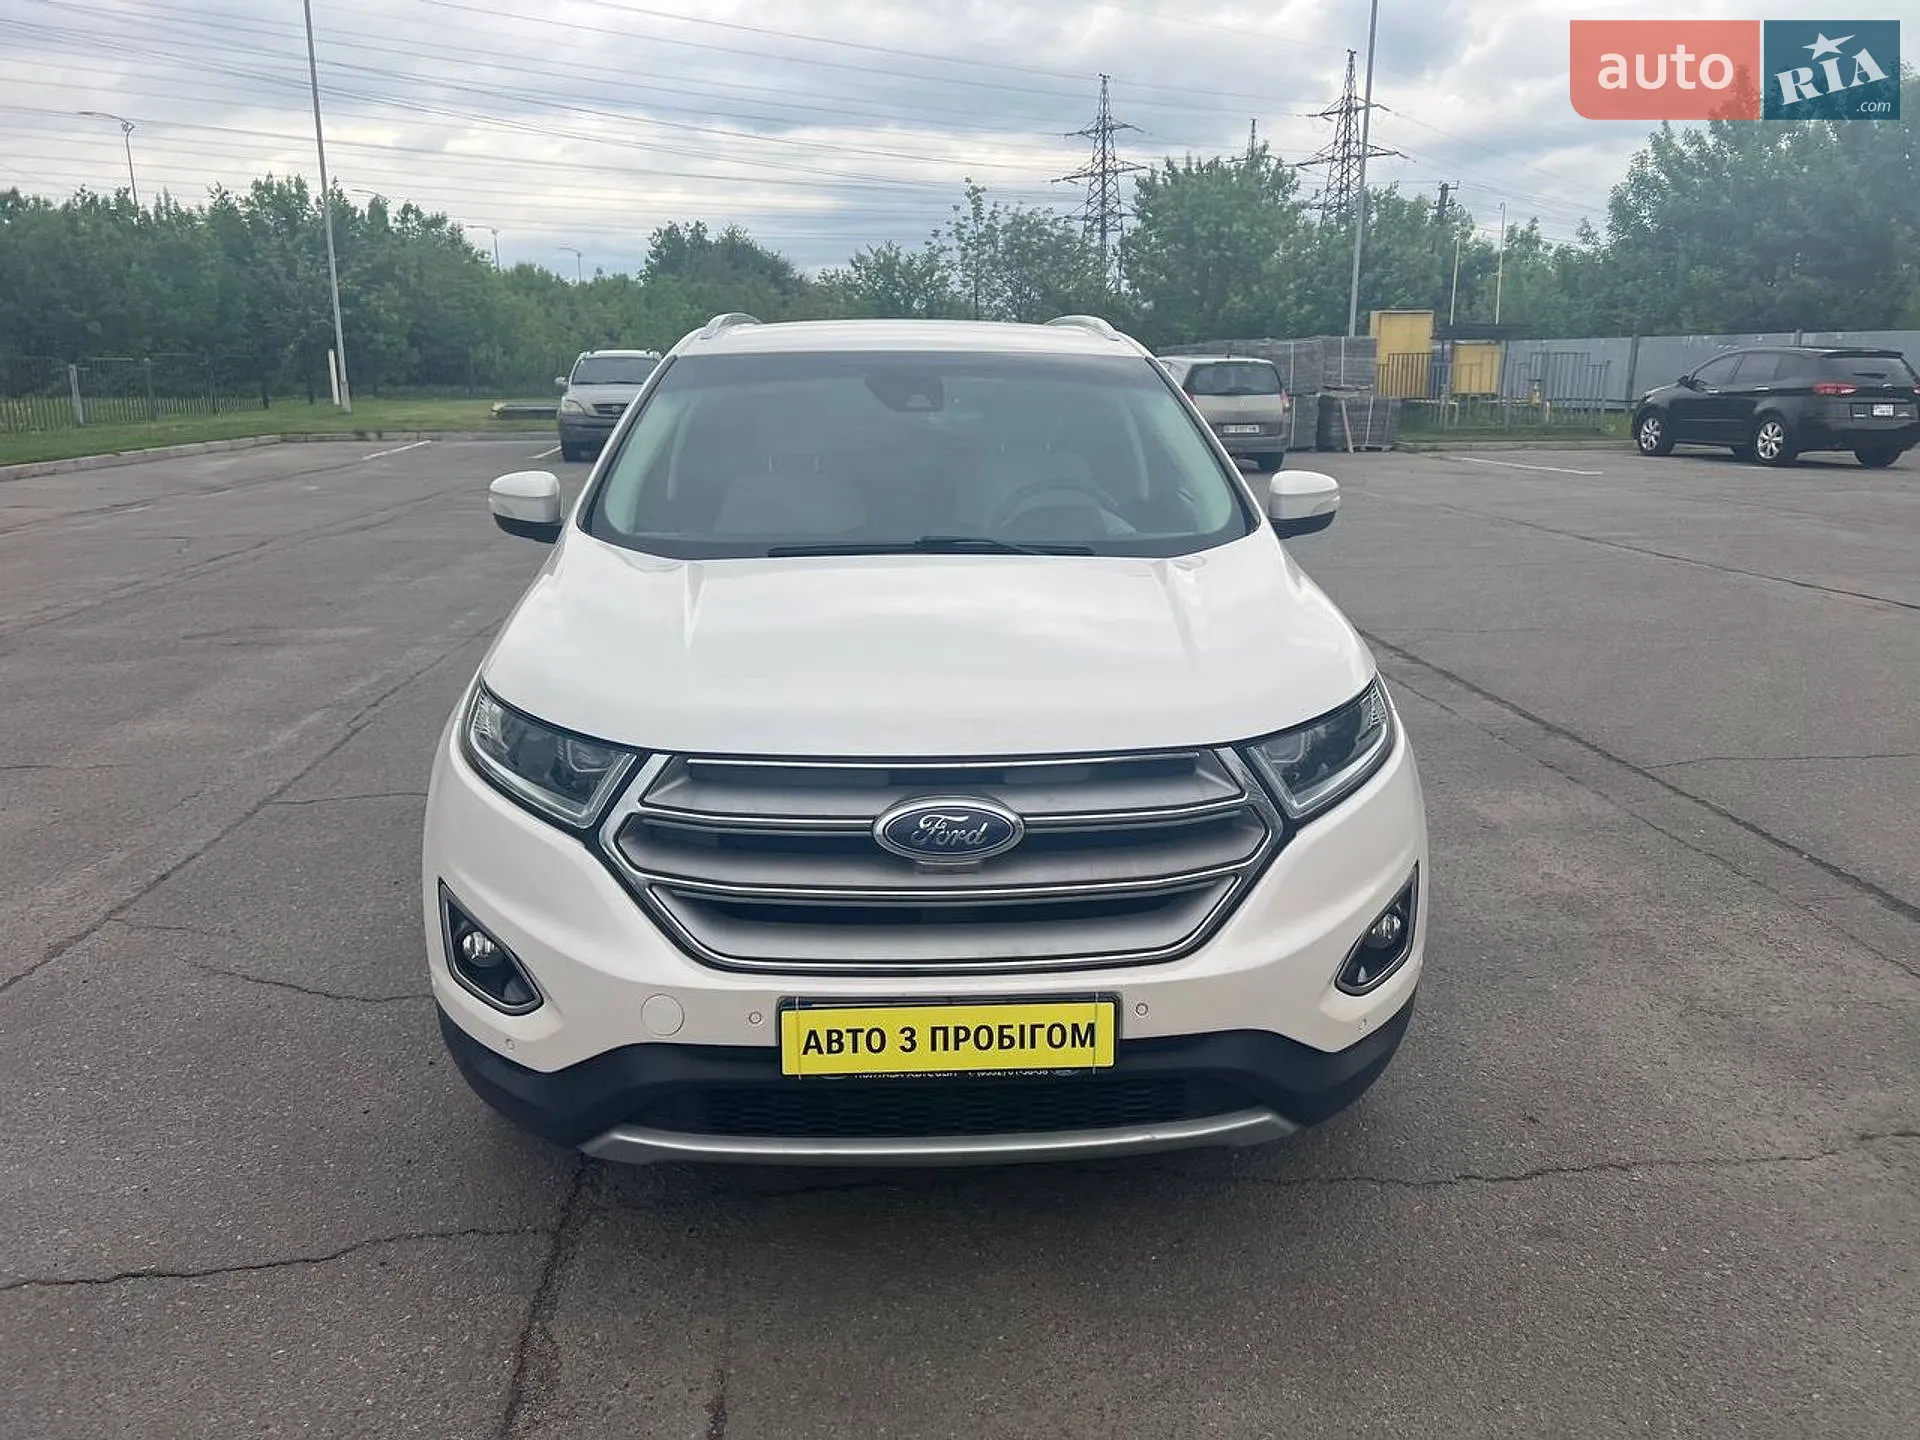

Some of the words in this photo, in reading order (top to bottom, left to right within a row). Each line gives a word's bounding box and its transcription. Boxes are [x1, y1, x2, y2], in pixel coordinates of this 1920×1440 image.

[910, 814, 989, 846] Ford
[801, 1027, 887, 1056] АВТО
[930, 1022, 1096, 1052] ПРОБІГОМ
